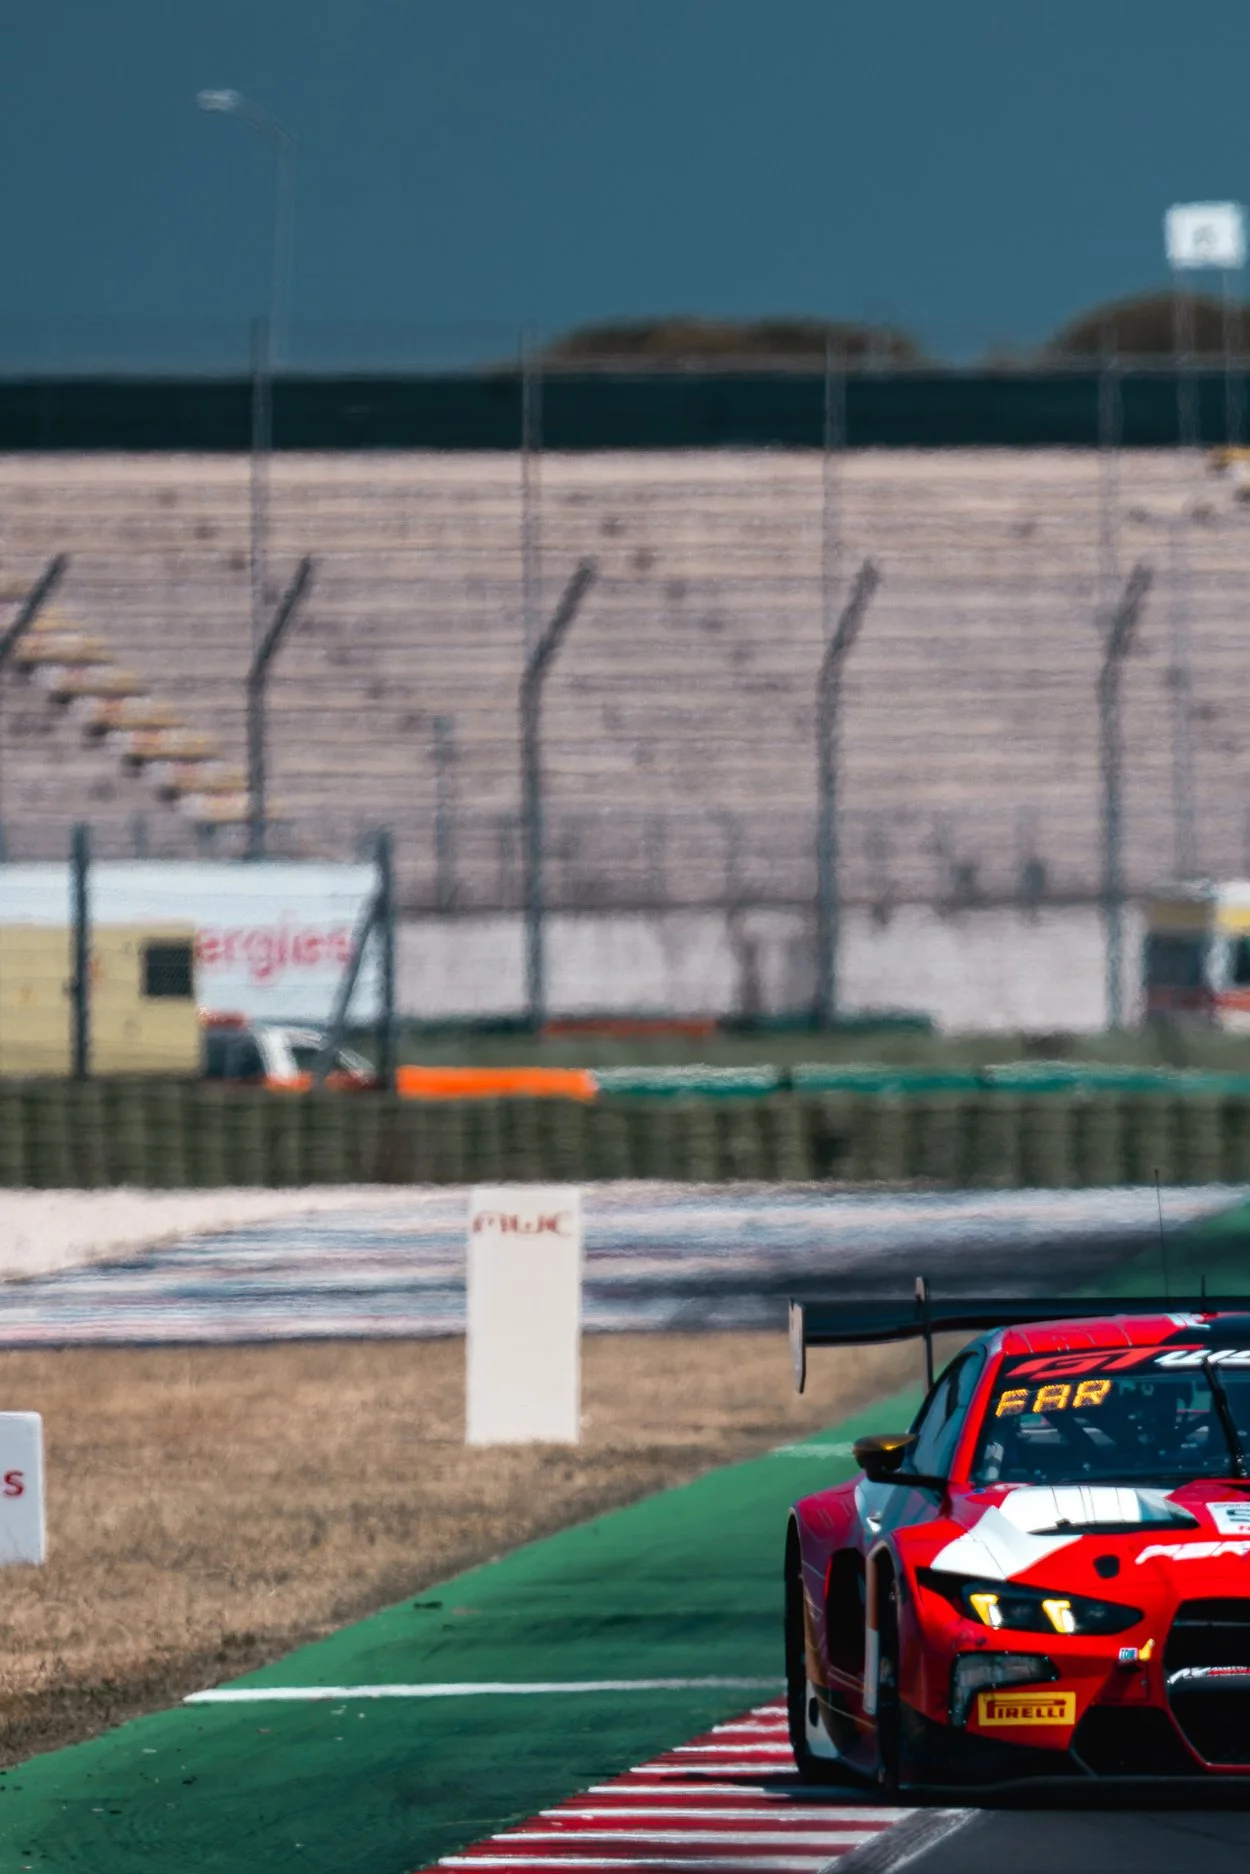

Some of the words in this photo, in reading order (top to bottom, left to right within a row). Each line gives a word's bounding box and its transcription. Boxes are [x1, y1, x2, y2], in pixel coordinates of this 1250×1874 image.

[1005, 1345, 1204, 1379] GT
[995, 1379, 1112, 1417] FAR
[986, 1698, 1066, 1719] PIRELLI
